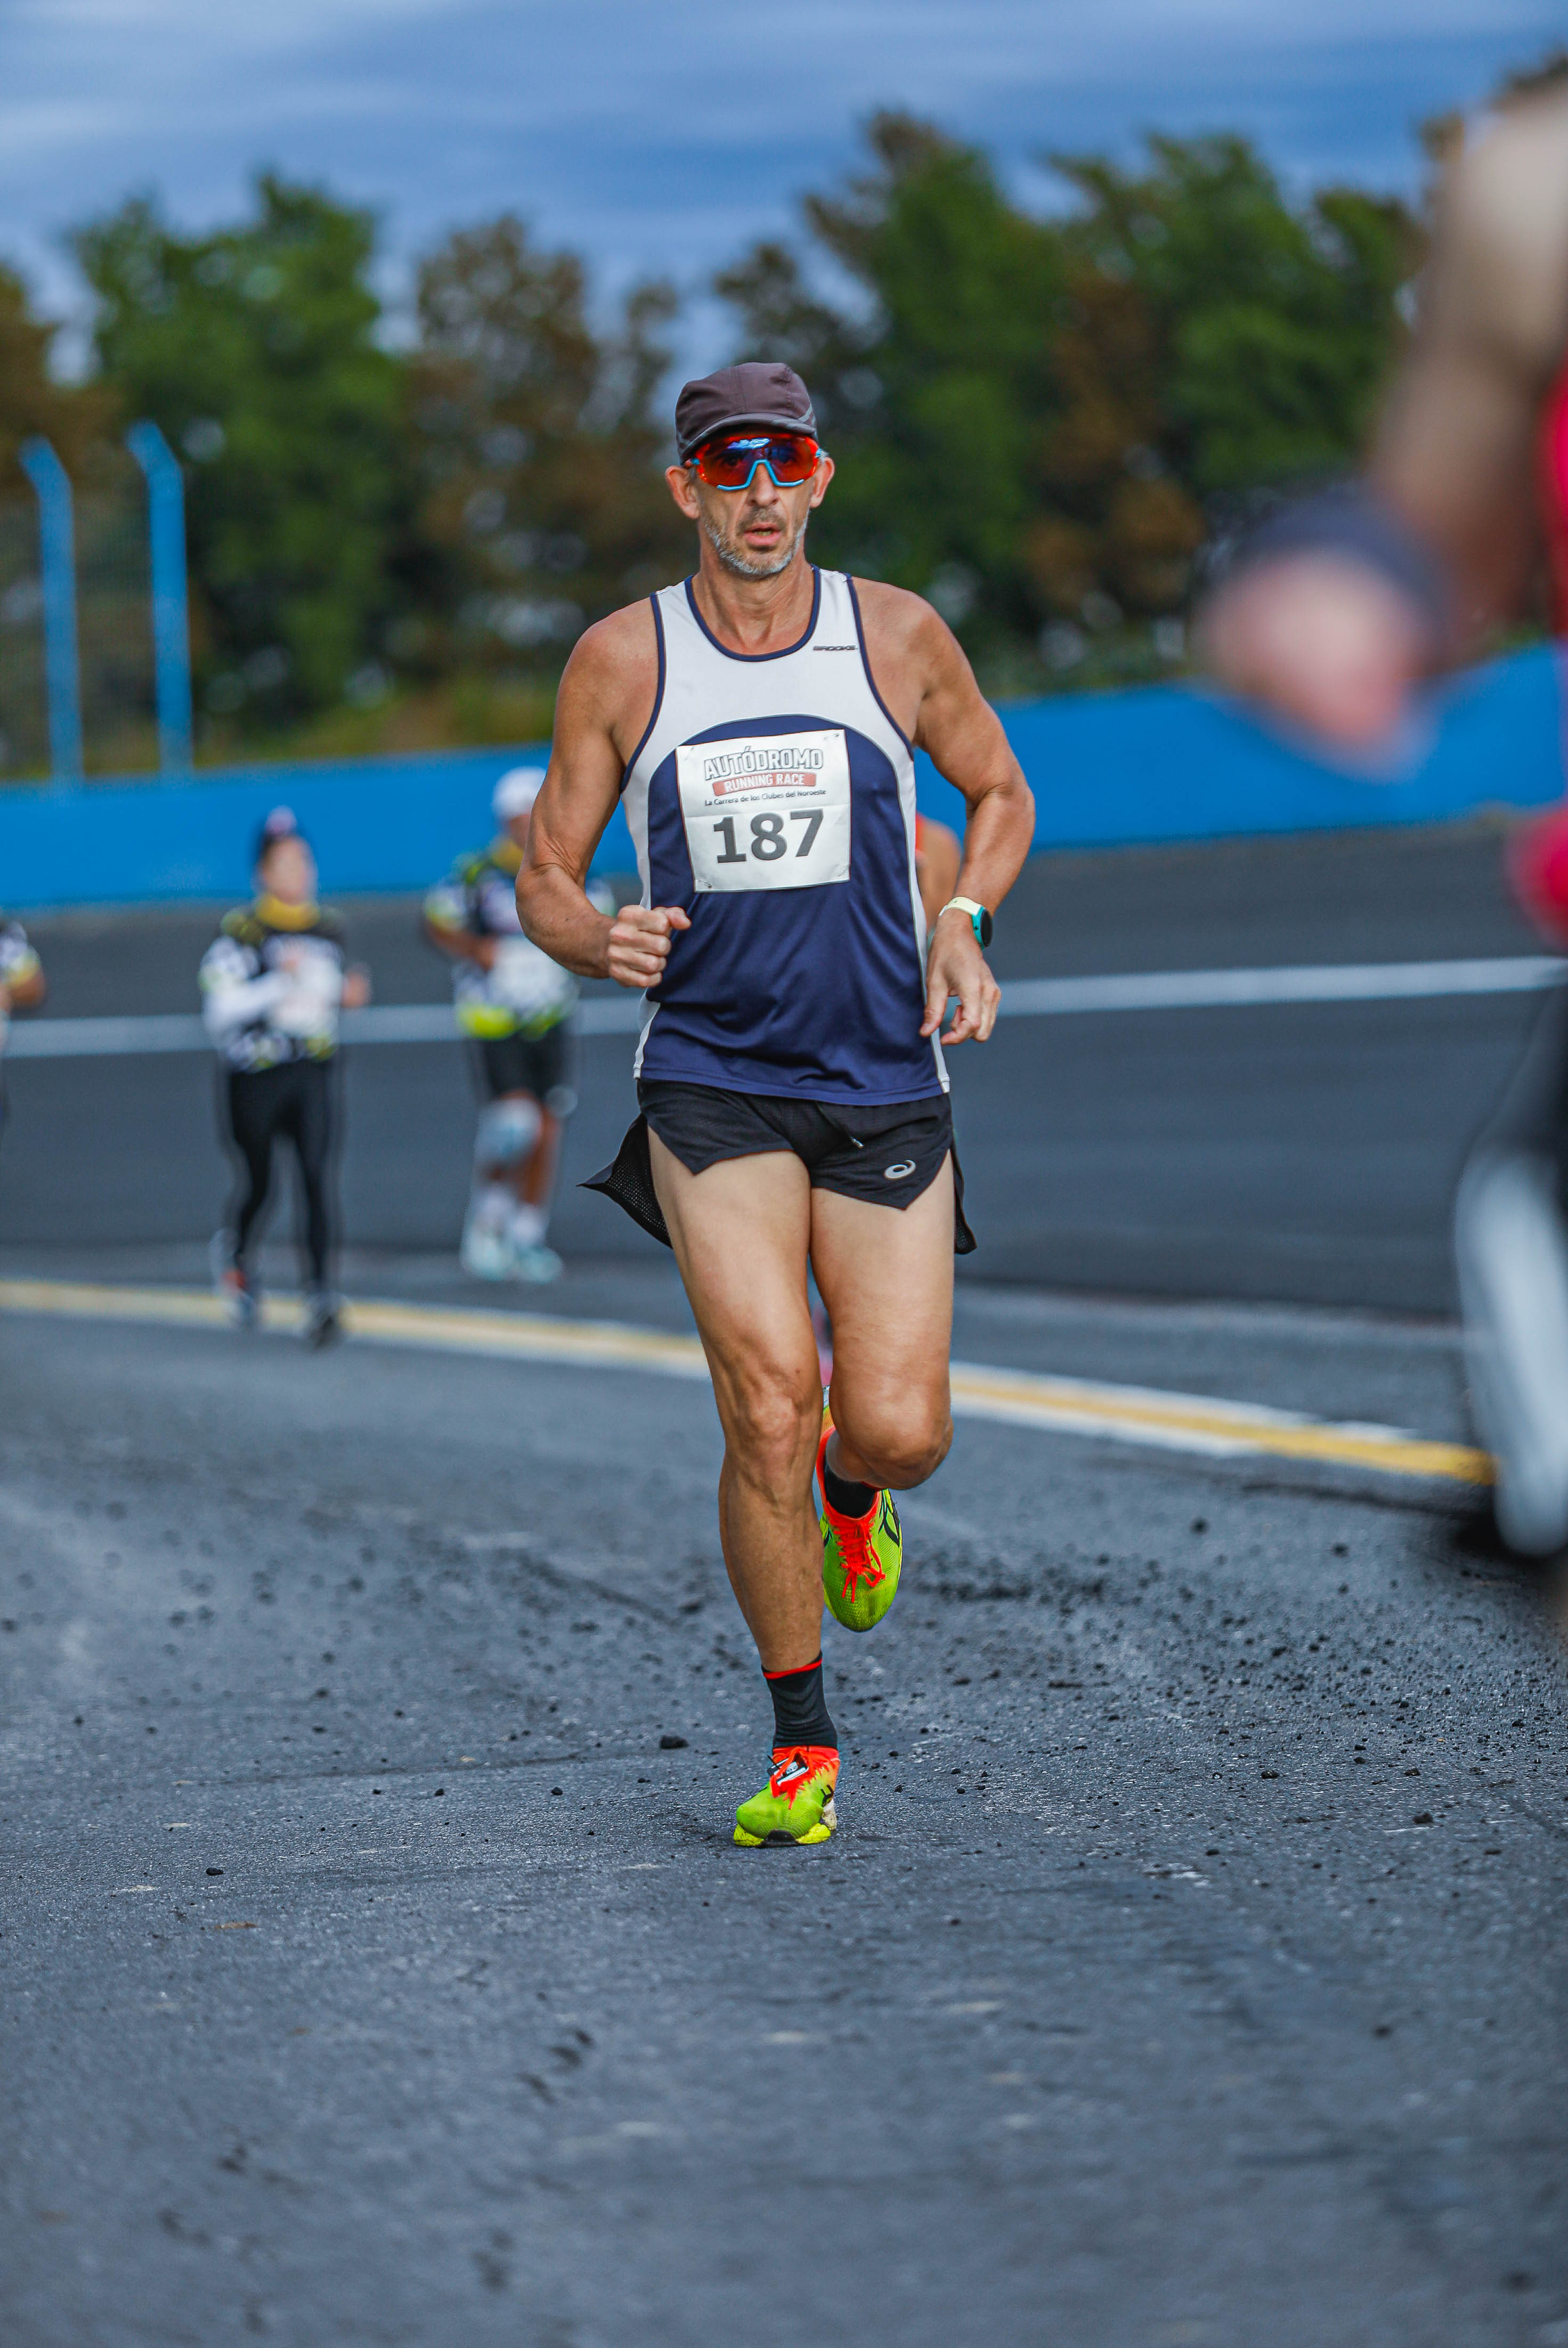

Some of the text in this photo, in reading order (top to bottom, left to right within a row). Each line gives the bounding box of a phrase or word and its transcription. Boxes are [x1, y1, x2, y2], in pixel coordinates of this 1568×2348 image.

[704, 745, 824, 781] AUTÓDROMO
[724, 773, 805, 793] RUNNING RACE
[713, 808, 824, 864] 187
